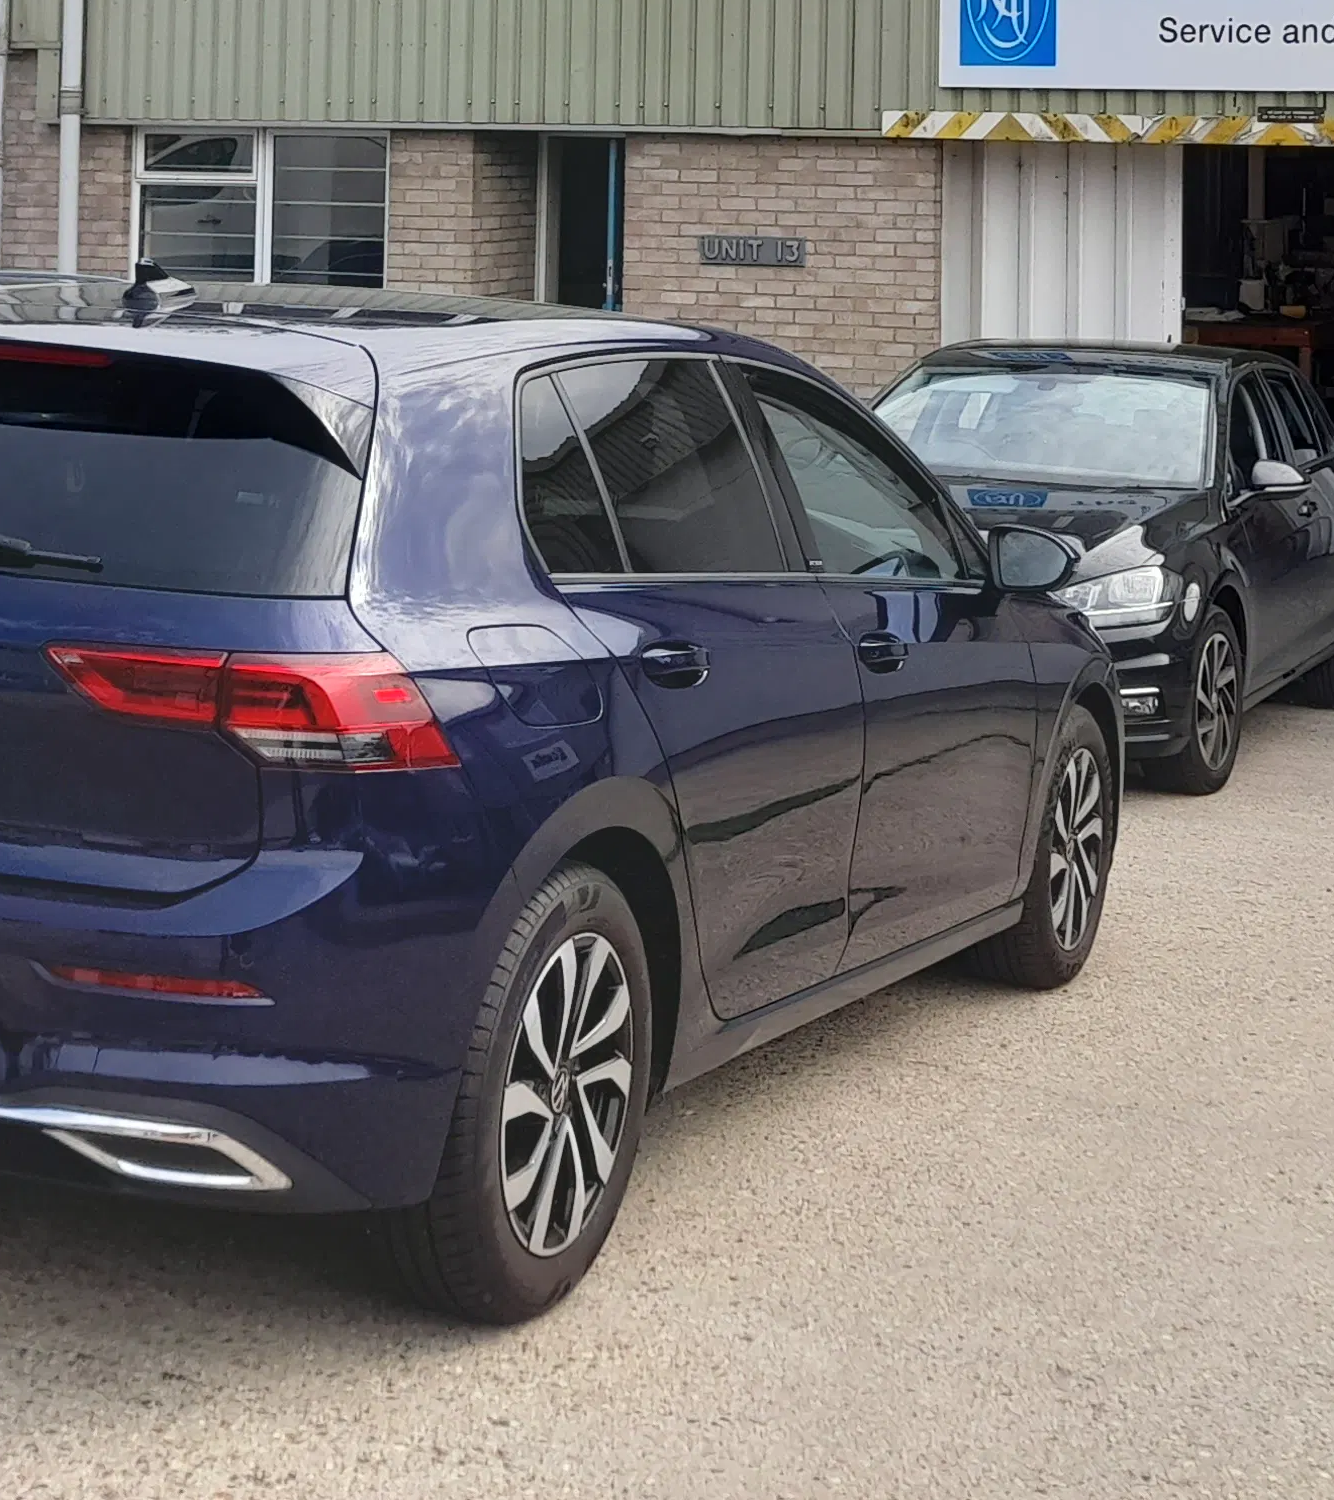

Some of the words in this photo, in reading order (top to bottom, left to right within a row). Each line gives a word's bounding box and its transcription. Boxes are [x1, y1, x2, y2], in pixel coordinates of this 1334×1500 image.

[1158, 16, 1272, 44] Service
[703, 238, 764, 262] UNIT
[776, 240, 800, 262] 13
